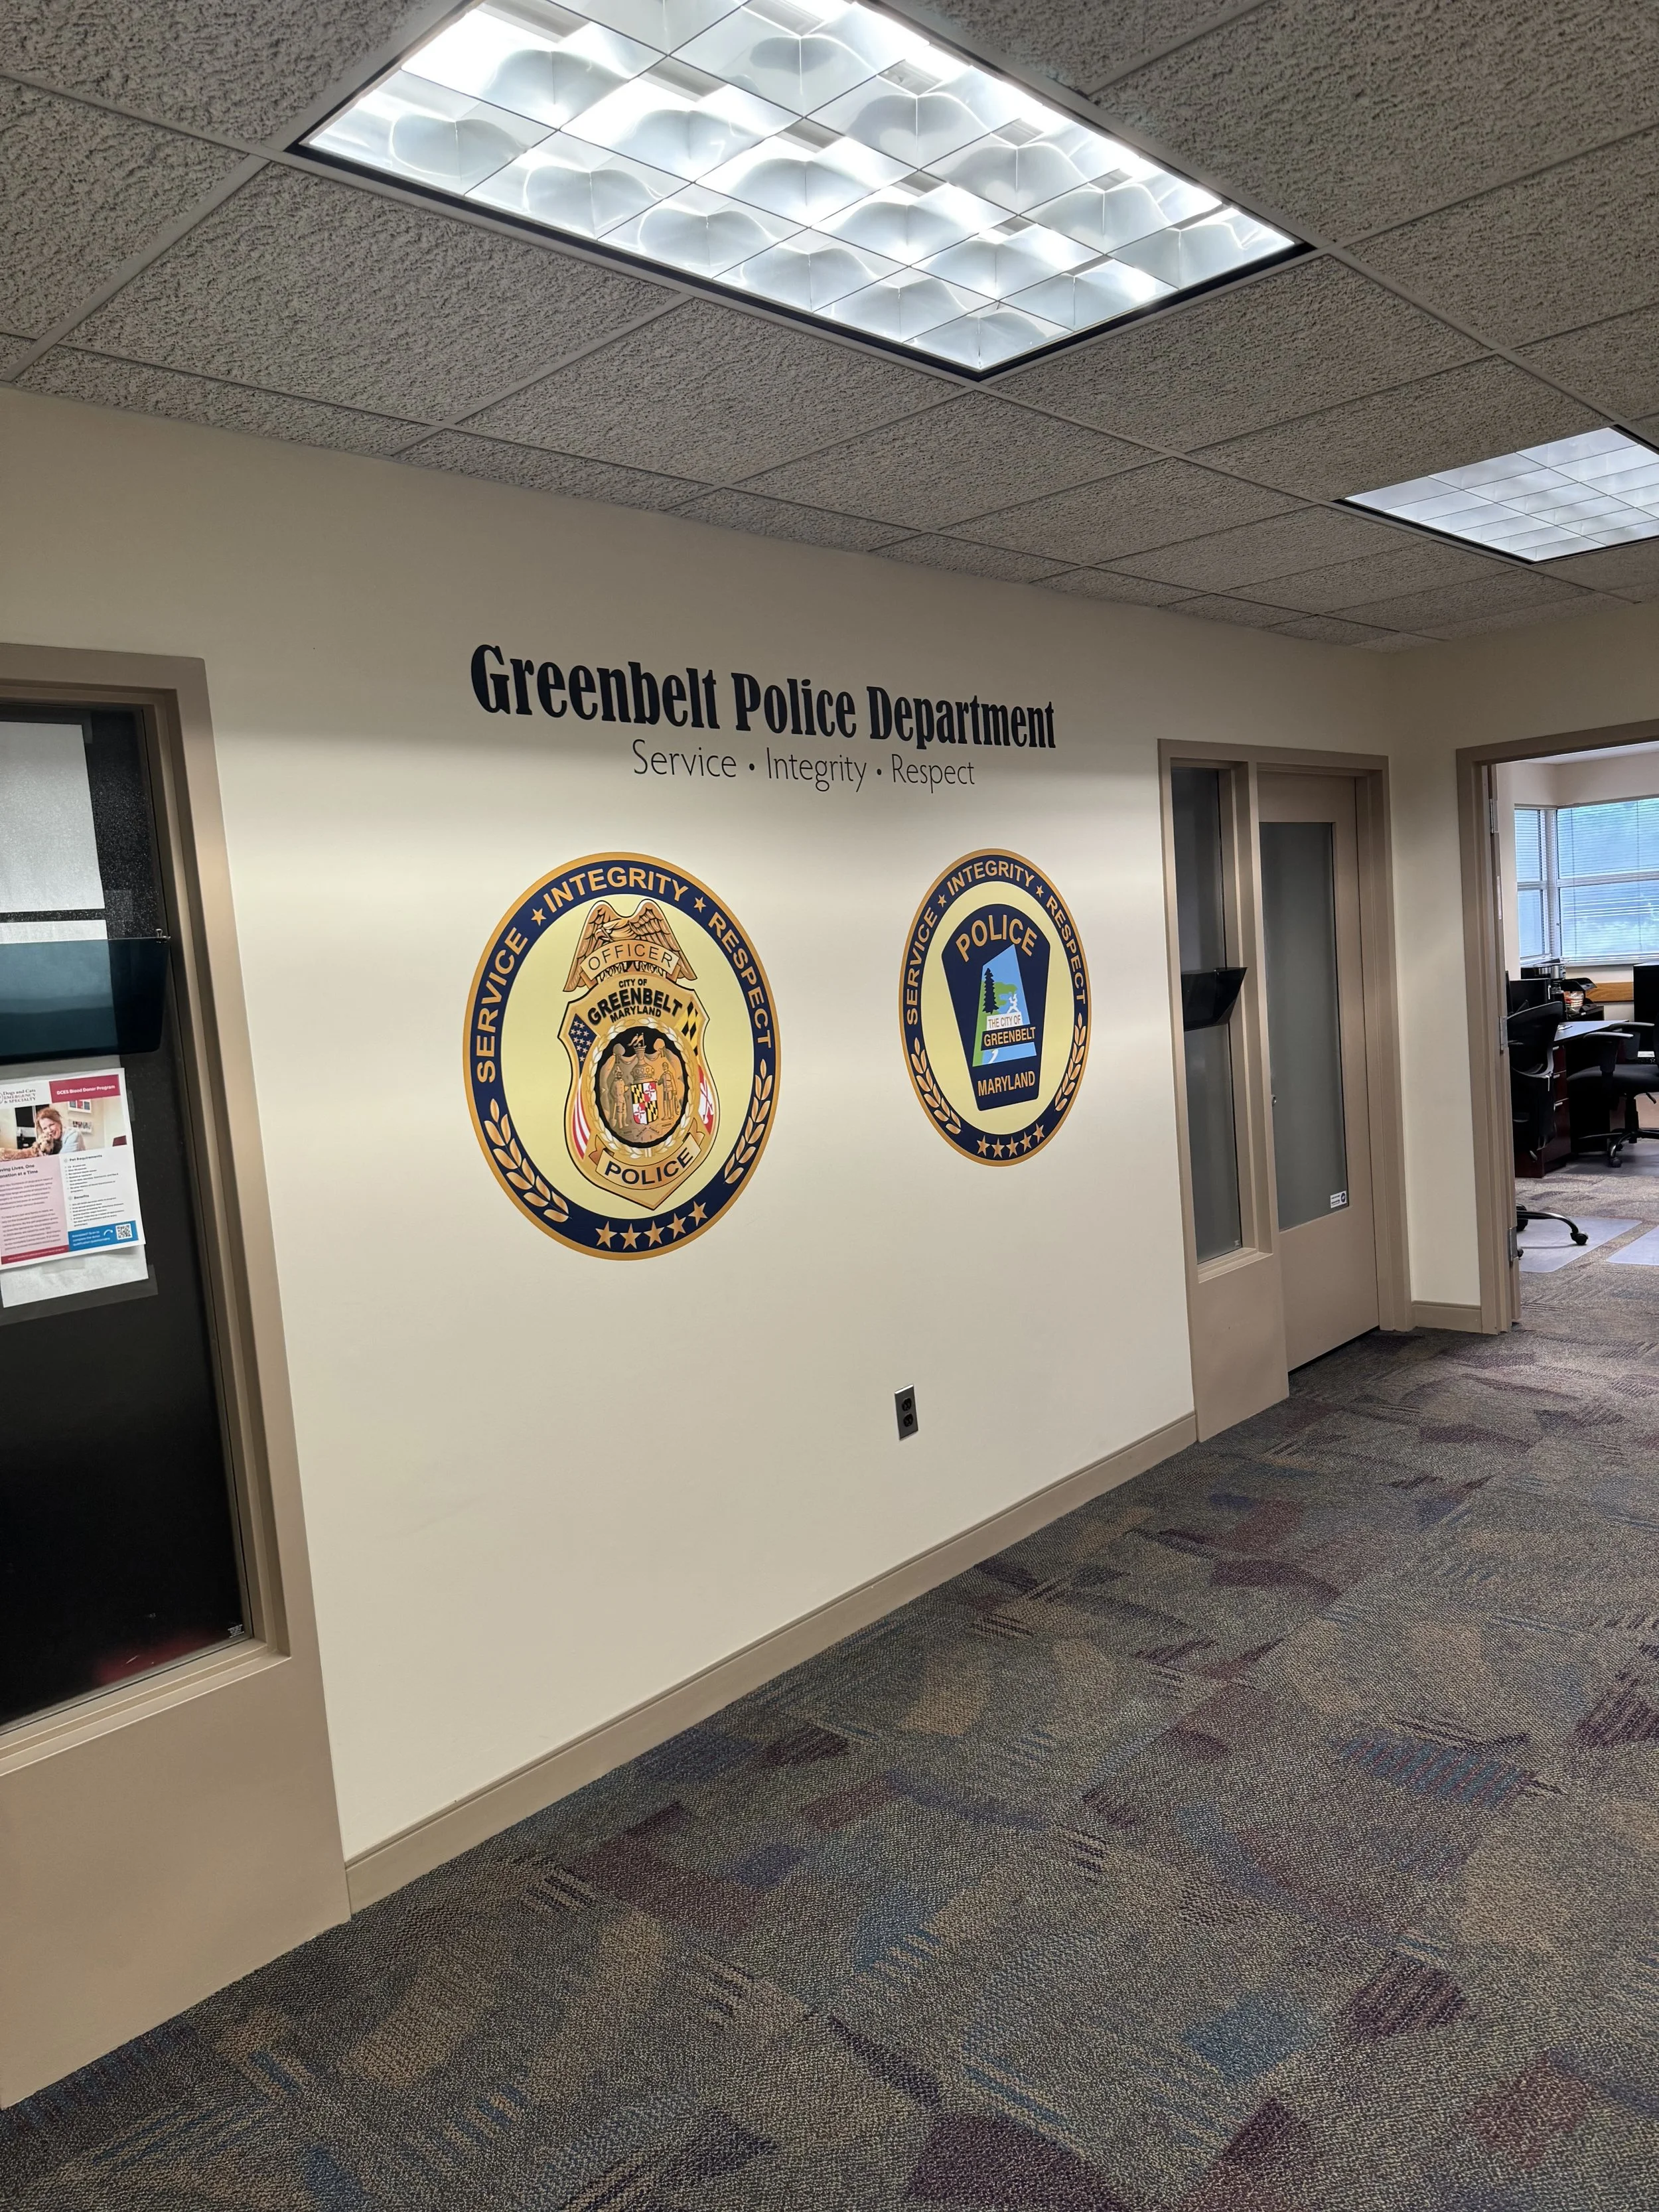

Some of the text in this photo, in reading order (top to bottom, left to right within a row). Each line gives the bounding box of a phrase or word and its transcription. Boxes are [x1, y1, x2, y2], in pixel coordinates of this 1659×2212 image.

[470, 644, 1056, 750] Greenbelt Police Department
[632, 740, 975, 794] Service Integrity Respect
[906, 860, 1086, 1025] SERVICE INTEGRITY RESPECT
[956, 915, 1037, 962] POLICE
[476, 867, 771, 1082] SERVICE INTEGRITY RESPECT
[588, 944, 673, 972] OFFICER
[618, 979, 636, 988] CITY
[587, 988, 683, 1025] GREENBELT
[610, 1005, 661, 1023] MARYLAND
[988, 1015, 1021, 1029] THE CITY OF
[983, 1027, 1036, 1047] GREENBELT
[977, 1070, 1036, 1096] MARYLAND
[605, 1149, 693, 1185] POLICE
